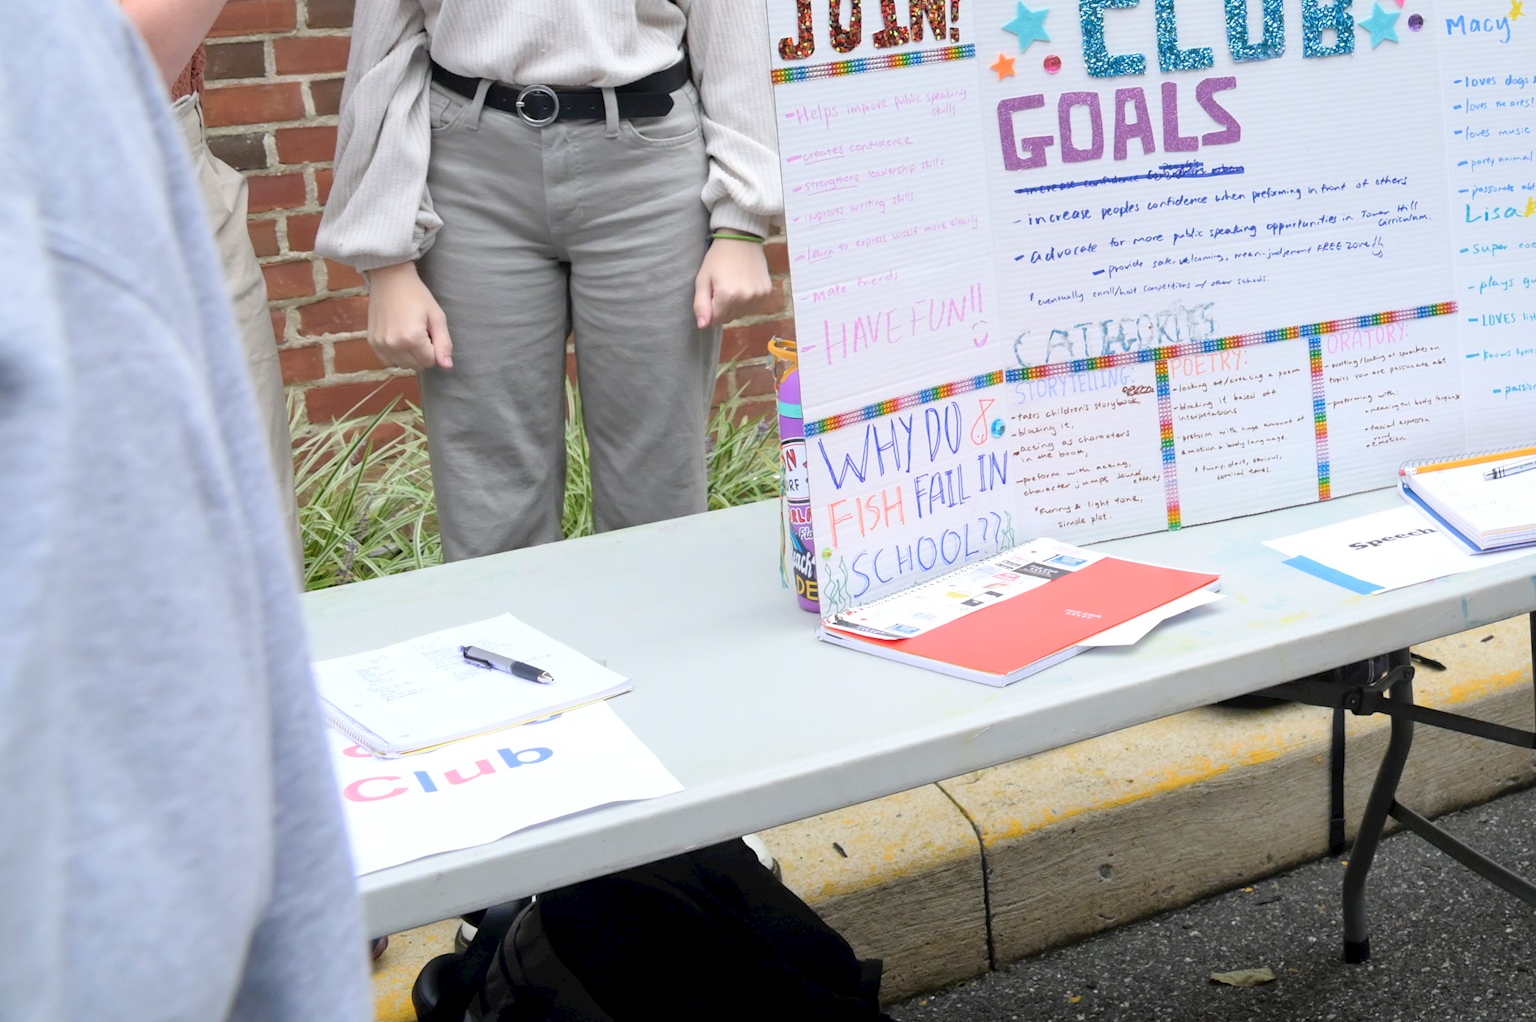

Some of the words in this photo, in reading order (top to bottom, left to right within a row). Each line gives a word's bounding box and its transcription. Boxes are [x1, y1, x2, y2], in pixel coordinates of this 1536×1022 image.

[796, 105, 838, 129] Helps
[848, 98, 888, 115] improve
[894, 93, 921, 110] public
[926, 87, 967, 106] speaking
[932, 104, 956, 117] skills
[997, 75, 1242, 172] GOALS
[803, 146, 844, 162] creates
[849, 137, 913, 152] confidence
[805, 173, 860, 191] strengthens
[868, 163, 916, 179] leadership
[921, 157, 944, 169] skills
[850, 199, 885, 214] writing
[892, 191, 915, 204] skills
[1465, 203, 1521, 222] Lisa
[838, 242, 848, 250] to
[856, 234, 887, 248] express
[924, 223, 947, 232] more
[950, 214, 979, 229] clearly
[813, 284, 847, 303] Make
[857, 271, 899, 288] friends
[1013, 300, 1215, 369] CATEGORIES
[1482, 309, 1516, 326] LOVES
[824, 307, 903, 365] HAVE
[1327, 321, 1408, 354] ORATORY:
[1170, 349, 1248, 378] POETRY:
[1015, 367, 1135, 405] STORYTELLING:
[818, 413, 913, 490] WHY
[925, 401, 962, 462] DO
[828, 485, 905, 549] FISH
[914, 464, 971, 519] FAIL
[977, 450, 1008, 492] IN
[1348, 528, 1438, 550] Speech
[342, 747, 554, 803] Club
